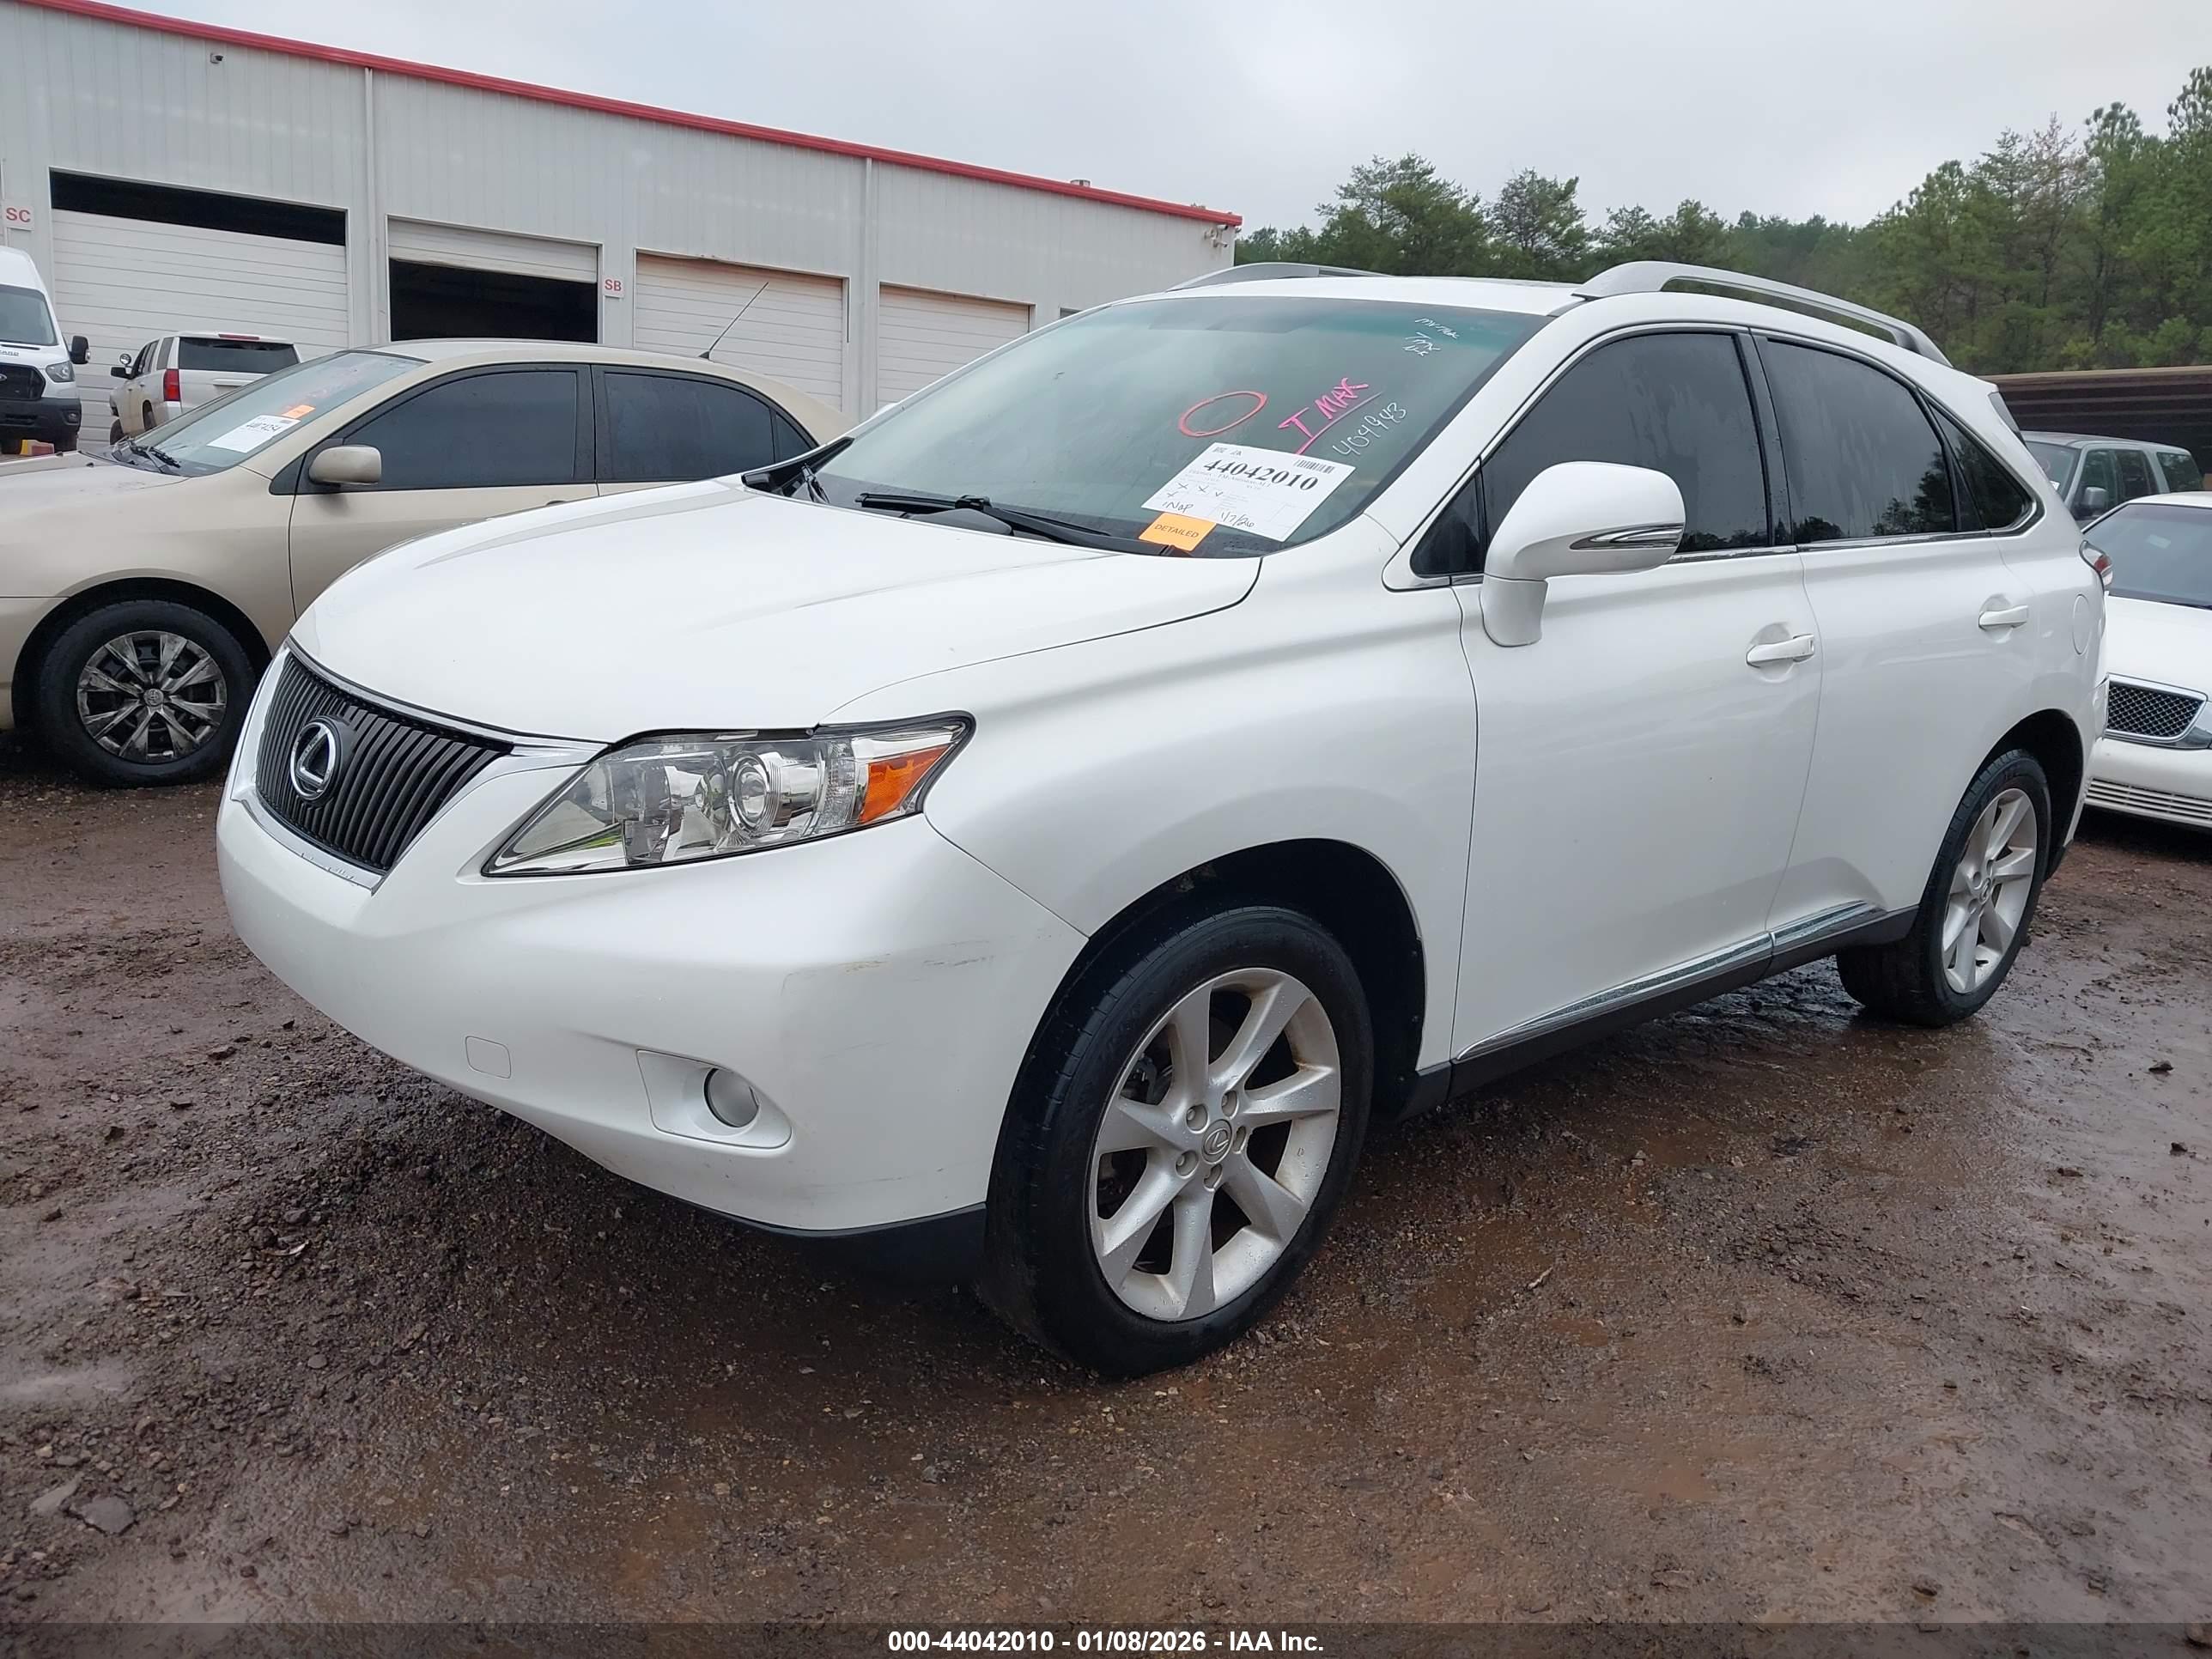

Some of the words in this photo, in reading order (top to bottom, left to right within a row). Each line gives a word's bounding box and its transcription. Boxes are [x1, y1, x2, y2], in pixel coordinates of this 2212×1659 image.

[5, 206, 32, 223] SC
[604, 278, 623, 292] SB
[1203, 459, 1319, 491] 44042010
[1153, 523, 1200, 539] DETAILED
